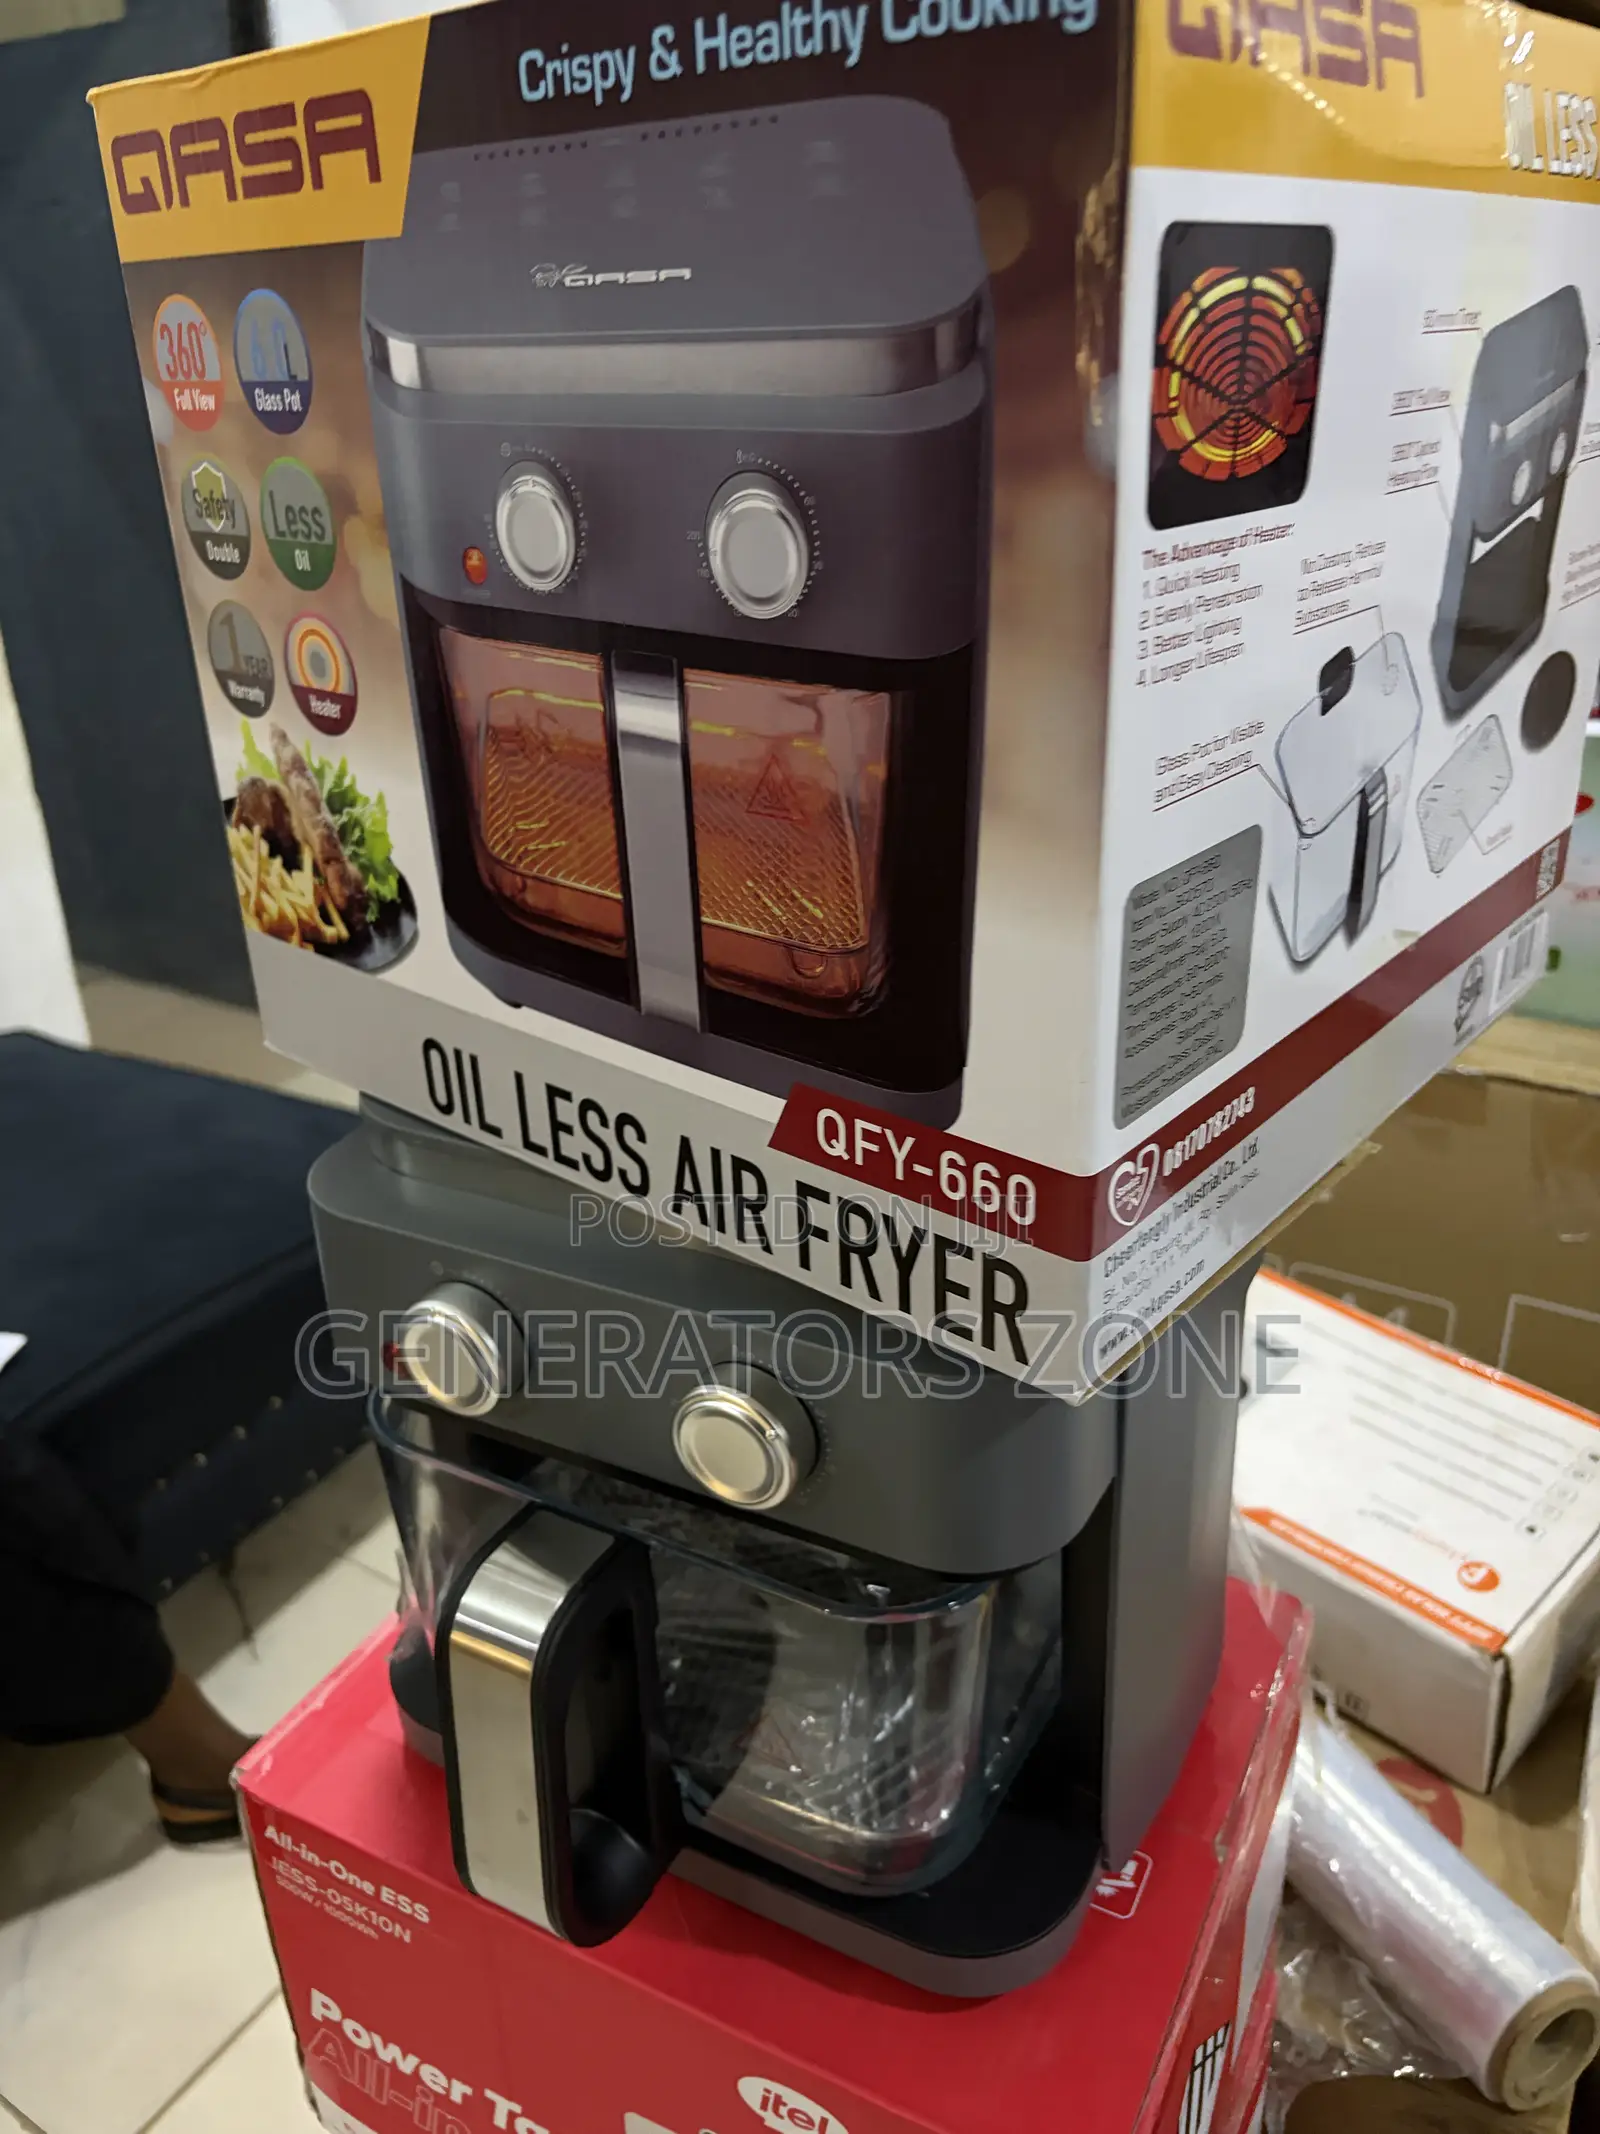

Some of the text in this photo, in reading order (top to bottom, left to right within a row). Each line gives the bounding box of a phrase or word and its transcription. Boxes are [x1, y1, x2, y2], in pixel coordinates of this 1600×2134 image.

[518, 43, 636, 106] Crispy
[648, 25, 683, 81] &
[694, 0, 867, 69] Healthy
[111, 88, 382, 215] QASA
[160, 321, 207, 380] 360°
[173, 388, 216, 412] Full View
[254, 388, 303, 412] Glass Pot
[193, 488, 236, 529] Safety
[269, 490, 327, 543] Less
[206, 540, 241, 564] Double
[295, 549, 312, 572] Oil
[816, 1107, 1037, 1226] QFY-660
[422, 1037, 503, 1140] OIL
[513, 1070, 650, 1198] LESS
[671, 1135, 774, 1256] AIR
[795, 1179, 1030, 1367] FRYER
[264, 1824, 430, 1924] All-in-One ESS
[311, 1987, 473, 2104] Power
[759, 2087, 828, 2134] itel
